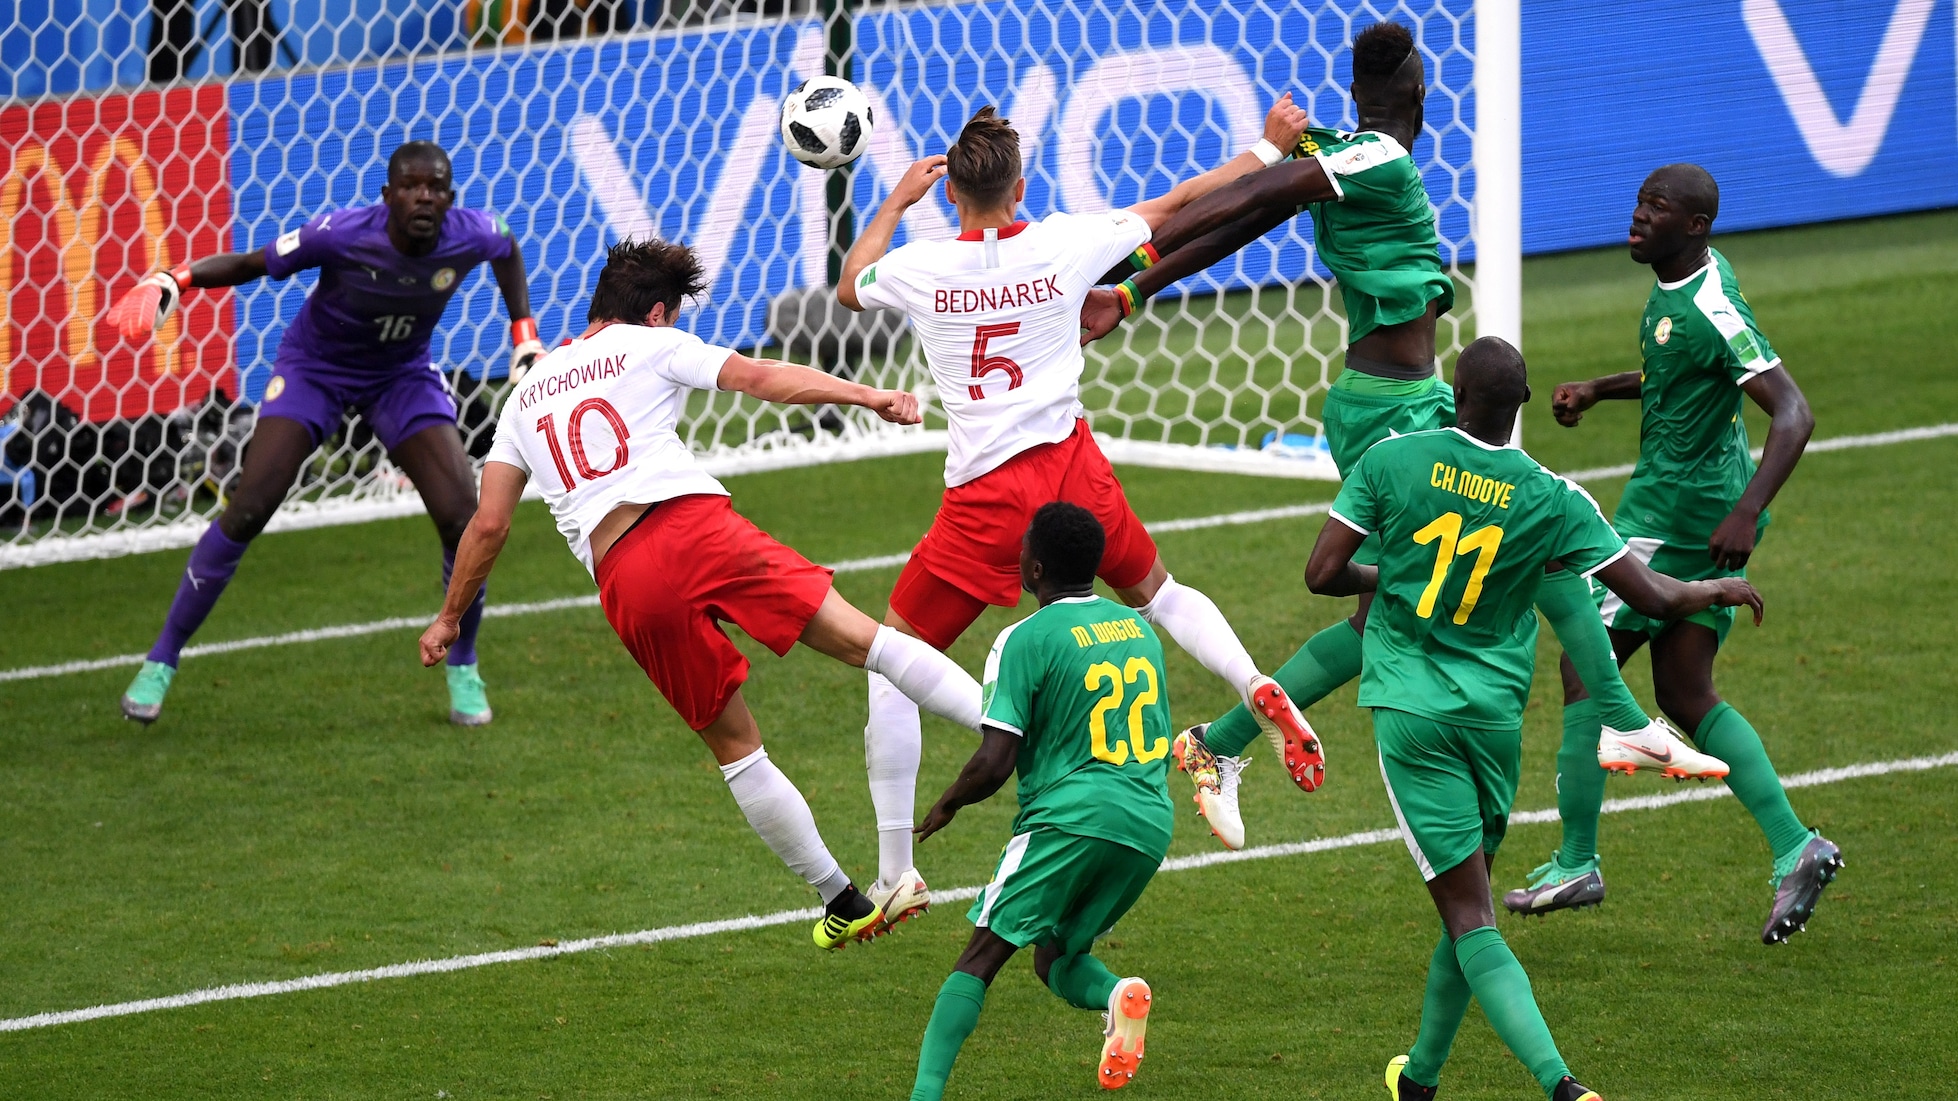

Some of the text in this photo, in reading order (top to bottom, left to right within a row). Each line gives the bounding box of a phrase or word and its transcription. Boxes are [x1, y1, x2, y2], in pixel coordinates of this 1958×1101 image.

[373, 314, 417, 343] 16
[934, 273, 1064, 314] BEDNAREK
[518, 352, 627, 412] KRYCHOWIAK
[967, 320, 1024, 401] 5
[535, 396, 631, 494] 10
[1430, 461, 1516, 510] CH.NDOYE
[1412, 511, 1505, 626] 11
[1083, 656, 1170, 767] 22
